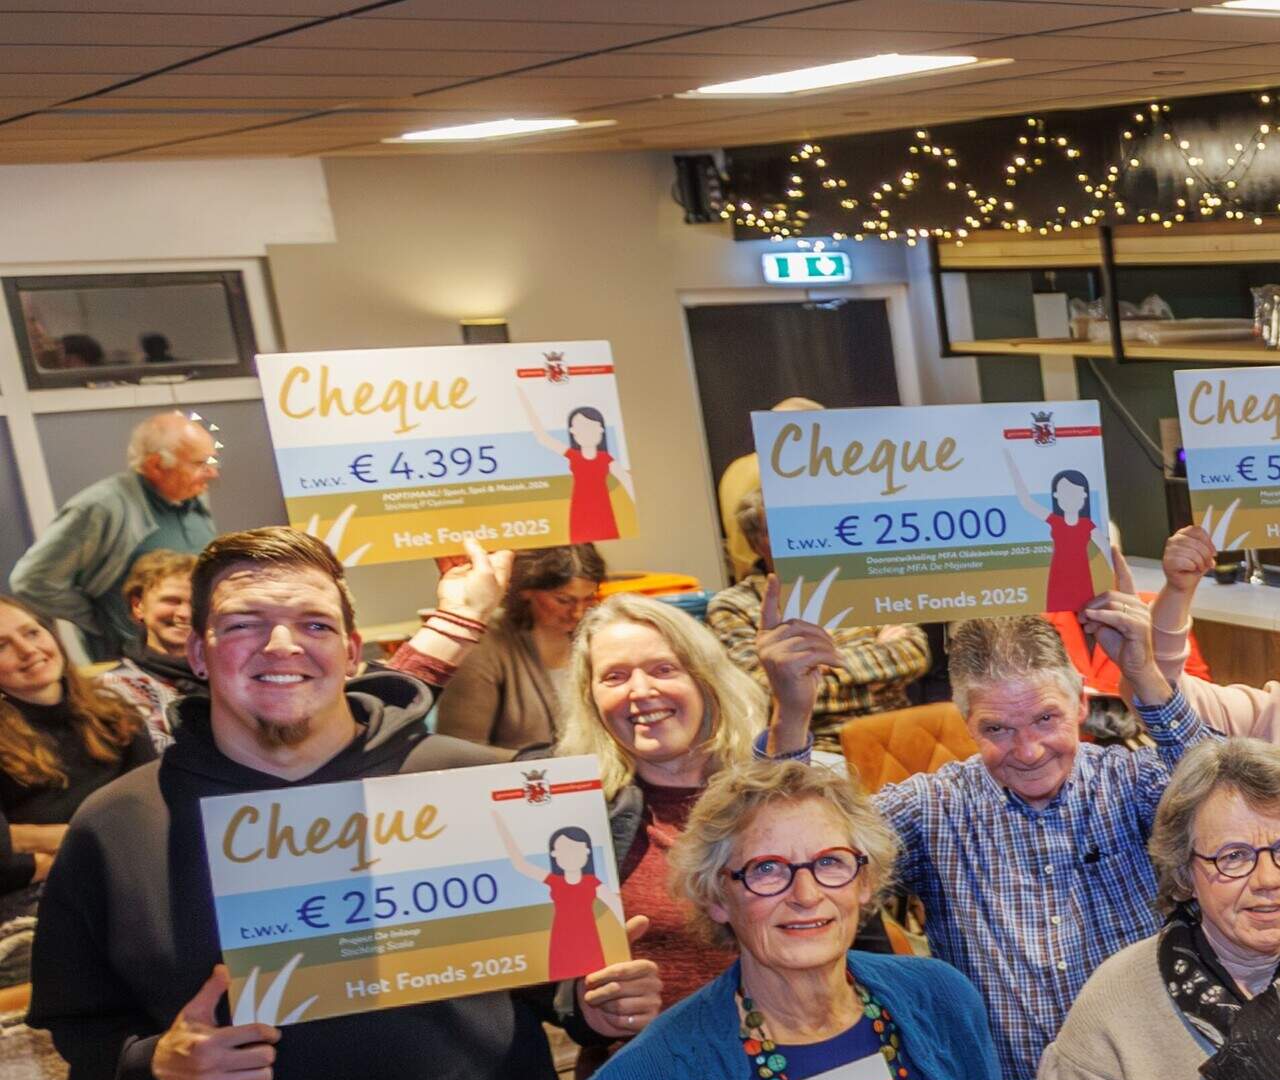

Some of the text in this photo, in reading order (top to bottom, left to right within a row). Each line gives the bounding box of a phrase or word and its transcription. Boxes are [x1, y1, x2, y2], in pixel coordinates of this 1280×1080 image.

[277, 363, 472, 436] Cheque
[299, 445, 497, 489] t.w.v. € 4.395
[769, 422, 963, 496] Cheque
[1200, 473, 1233, 484] t.w.v.
[1235, 455, 1257, 481] €
[393, 519, 549, 549] Het Fonds 2025
[786, 507, 1006, 550] t.w.v. € 25.000
[875, 587, 1028, 613] Het Fonds 2025
[224, 802, 444, 869] Cheque
[239, 873, 497, 939] t.w.v. € 25.000
[346, 954, 527, 998] Het Fonds 2025
